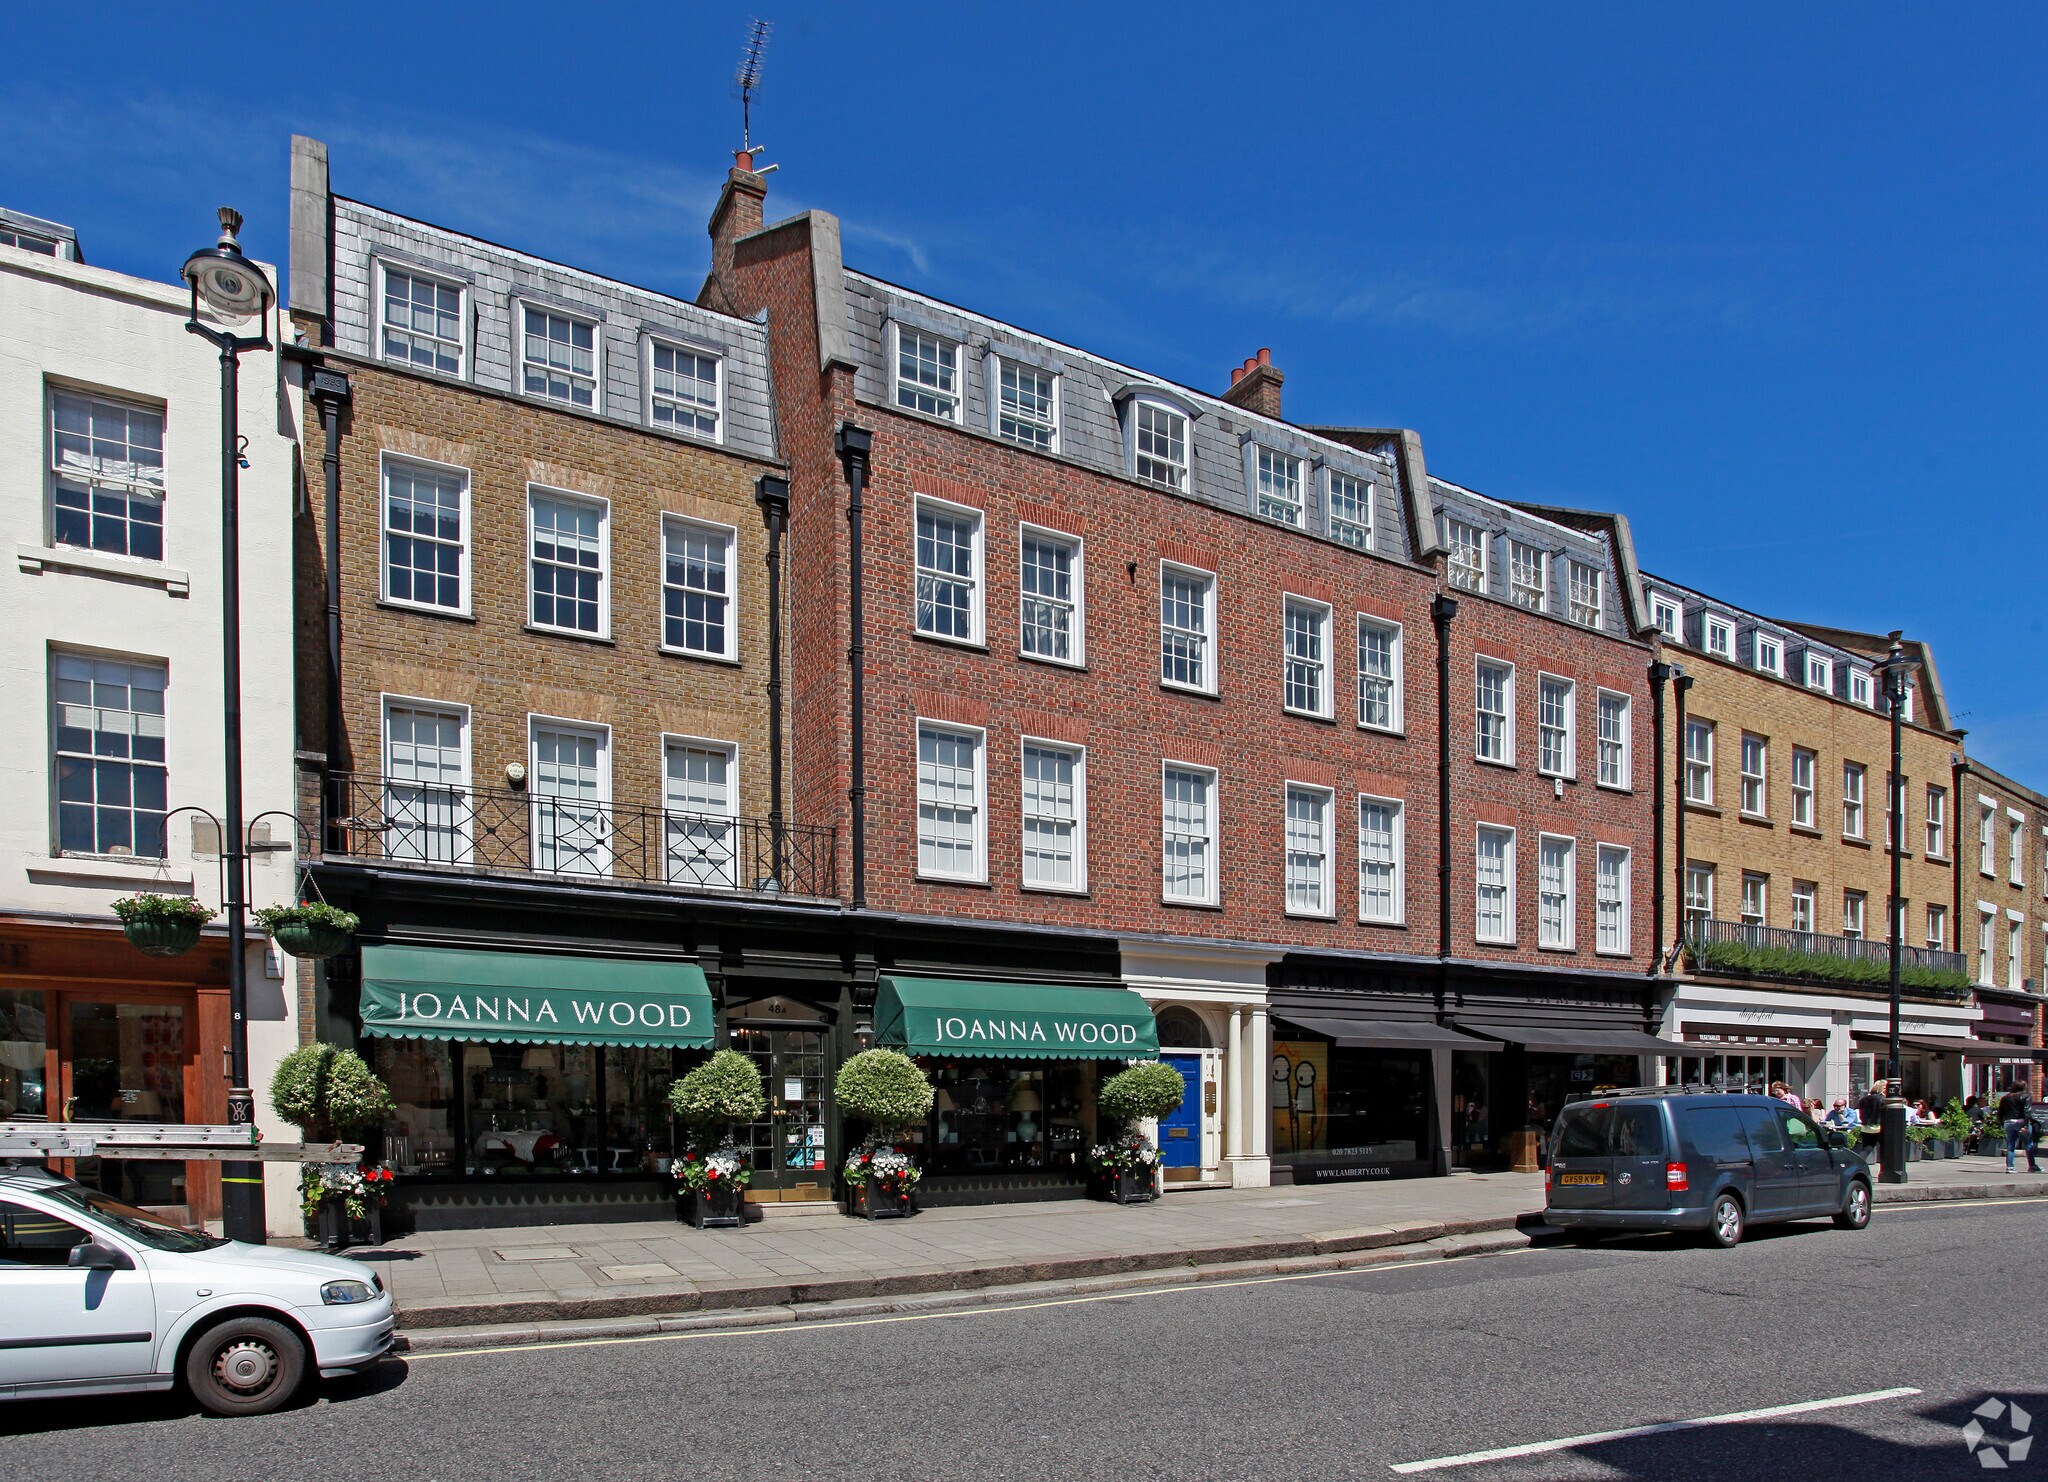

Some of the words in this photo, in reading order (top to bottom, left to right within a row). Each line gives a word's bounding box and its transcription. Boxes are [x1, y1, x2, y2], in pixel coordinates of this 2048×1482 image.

[396, 992, 559, 1025] JOANNA
[571, 1001, 692, 1028] WOOD
[234, 1012, 241, 1020] 8
[935, 1017, 1047, 1043] JOANNA
[1054, 1022, 1138, 1045] WOOD
[1332, 1148, 1343, 1156] 020
[1359, 1147, 1373, 1155] 5115
[1316, 1167, 1390, 1177] WWW.LAMBERTY.CO.UK
[1564, 1175, 1583, 1183] GV59
[1585, 1175, 1600, 1183] KVP
